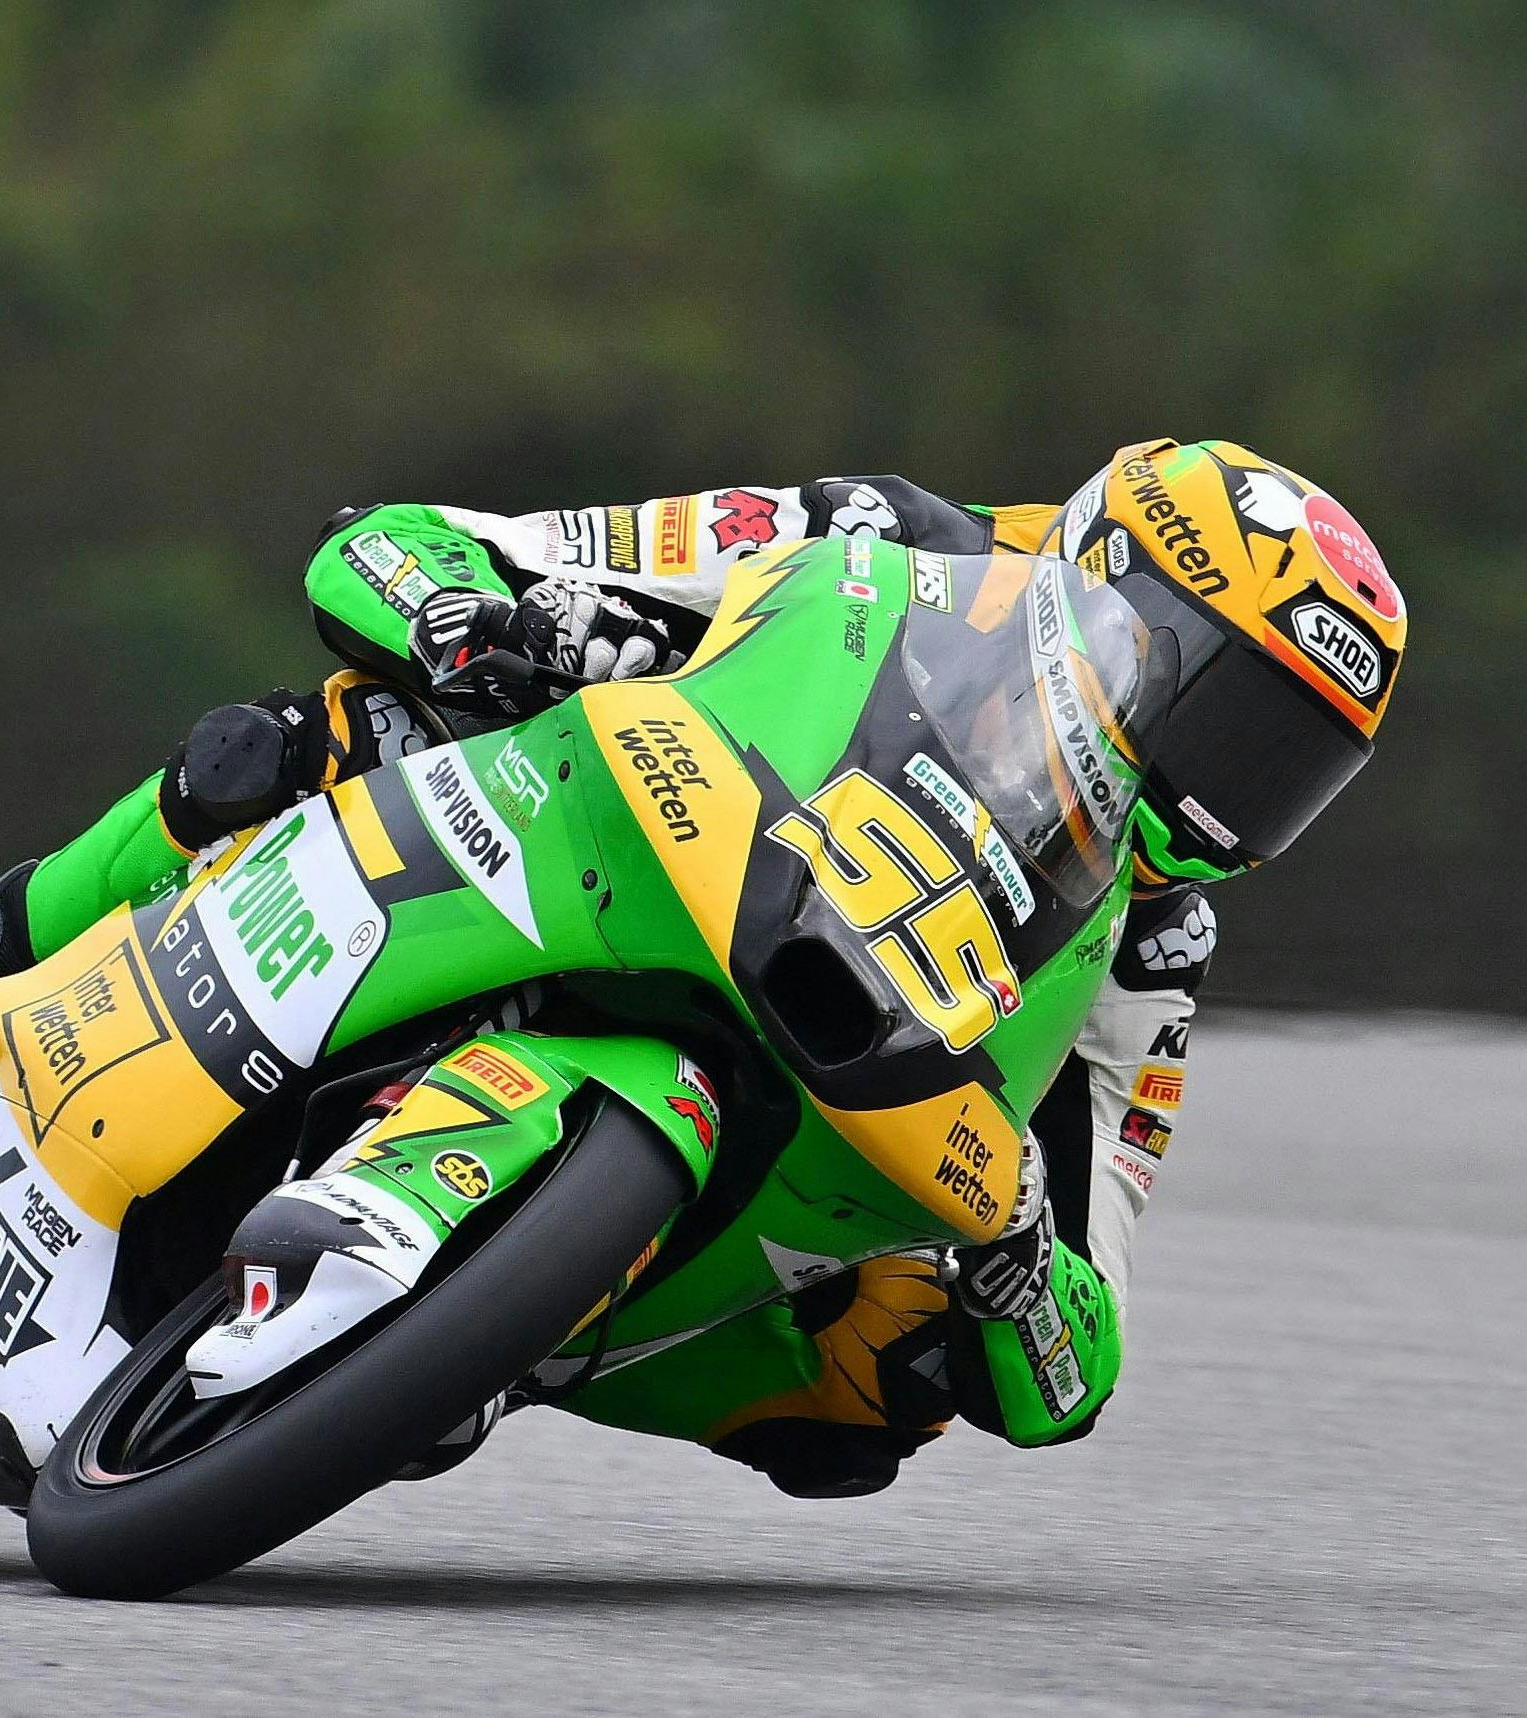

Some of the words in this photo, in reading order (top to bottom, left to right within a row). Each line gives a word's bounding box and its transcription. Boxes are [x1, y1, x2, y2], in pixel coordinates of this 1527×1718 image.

[1112, 535, 1126, 571] SHOEI
[844, 619, 855, 653] RACE
[1035, 569, 1059, 648] SHOEI
[1308, 613, 1376, 688] SHOEI
[639, 719, 713, 791] inter
[1049, 659, 1079, 723] SMP
[1068, 725, 1123, 827] VISION
[426, 757, 458, 803] SMP
[443, 793, 511, 878] VISION
[614, 728, 700, 842] wetten
[913, 760, 967, 817] Green
[988, 842, 1028, 910] Power
[220, 811, 334, 1002] Power
[763, 767, 1024, 1056] 55
[30, 1000, 87, 1085] wetten
[453, 1048, 534, 1101] PIRELLI
[436, 1152, 489, 1199] sbs
[945, 1112, 994, 1172] inter
[24, 1182, 82, 1248] MUGEN
[934, 1153, 999, 1226] wetten
[21, 1206, 66, 1257] RACE
[1032, 1296, 1055, 1344] reen
